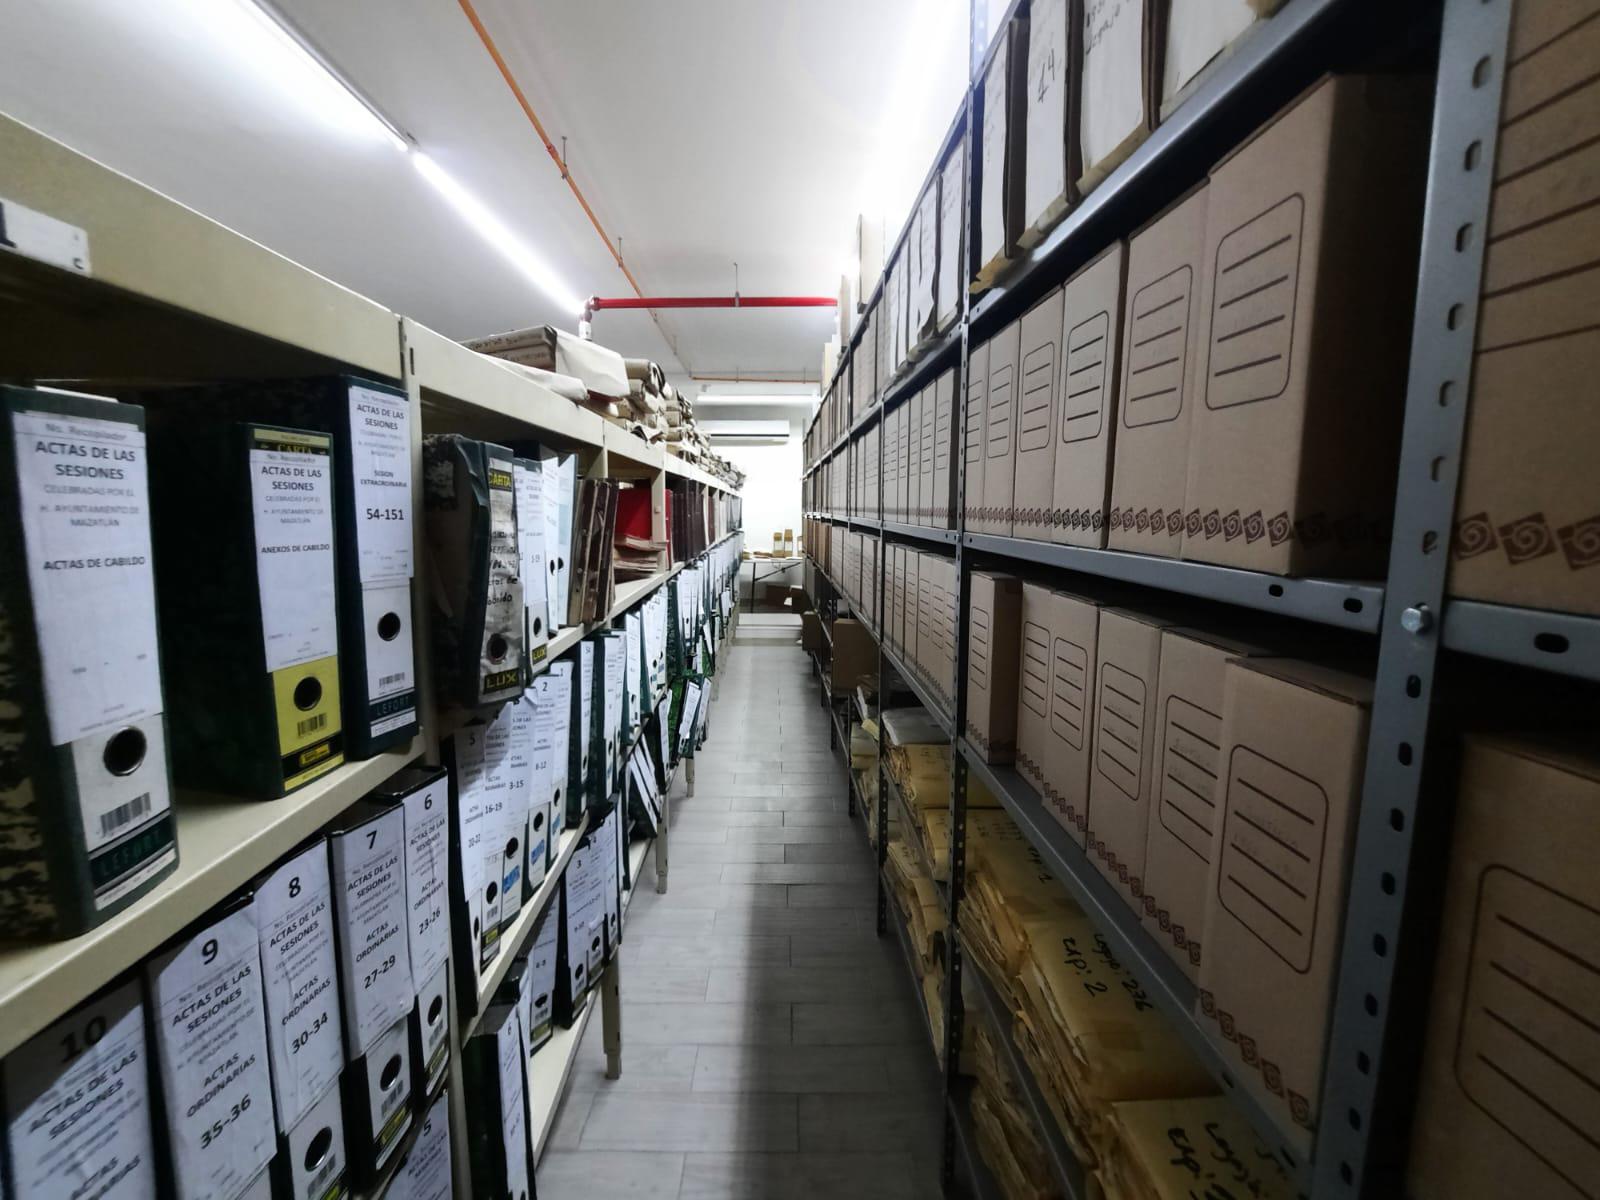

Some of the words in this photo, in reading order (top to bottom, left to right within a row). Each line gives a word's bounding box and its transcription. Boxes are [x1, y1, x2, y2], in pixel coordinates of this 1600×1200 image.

[357, 404, 380, 415] ACTAS
[381, 408, 392, 417] DE
[392, 410, 404, 420] LAS
[365, 418, 399, 430] SESIONES
[36, 441, 87, 457] ACTAS
[91, 447, 110, 459] DE
[114, 450, 136, 462] LAS
[55, 464, 124, 480] SESIONES
[261, 466, 292, 476] ACTAS
[293, 468, 305, 477] DE
[307, 469, 322, 478] LAS
[272, 481, 314, 491] SESIONES
[366, 508, 405, 521] 54-151
[261, 545, 291, 554] ANEXOS
[292, 544, 302, 552] DE
[303, 543, 331, 552] CABILDO
[43, 559, 84, 570] ACTAS
[87, 558, 101, 568] DE
[104, 556, 145, 567] CABILDO
[486, 671, 518, 689] LUX
[542, 682, 548, 692] 2
[424, 793, 433, 811] 6
[485, 802, 503, 814] 16-19
[366, 830, 378, 850] 7
[409, 829, 428, 847] ACTAS
[436, 817, 446, 829] LAS
[288, 876, 302, 898] 8
[347, 872, 373, 892] ACTAS
[374, 866, 384, 876] DE
[385, 855, 398, 869] LAS
[356, 872, 392, 899] SESIONES
[270, 922, 297, 948] ACTAS
[299, 913, 310, 927] DE
[312, 901, 326, 918] LAS
[366, 921, 389, 943] ACTAS
[418, 906, 441, 935] 23-26
[280, 920, 319, 955] SESIONES
[356, 924, 399, 963] ORDINARIAS
[201, 938, 219, 966] 9
[364, 954, 396, 990] 27-29
[172, 995, 211, 1027] ACTAS
[214, 982, 231, 1000] DE
[232, 965, 251, 986] LAS
[281, 978, 331, 1026] ORDINARIAS
[293, 975, 319, 1002] ACTAS
[1084, 981, 1108, 997] 2
[187, 987, 242, 1033] SESIONES
[60, 1014, 108, 1065] 10
[292, 1011, 328, 1055] 30-34
[204, 1052, 240, 1089] ACTAS
[28, 1089, 84, 1136] ACTAS
[87, 1072, 108, 1092] DE
[112, 1050, 138, 1076] LAS
[186, 1054, 256, 1118] ORDINARIAS
[49, 1077, 125, 1141] SESIONES
[200, 1094, 251, 1150] 35-36
[424, 1118, 432, 1137] 5
